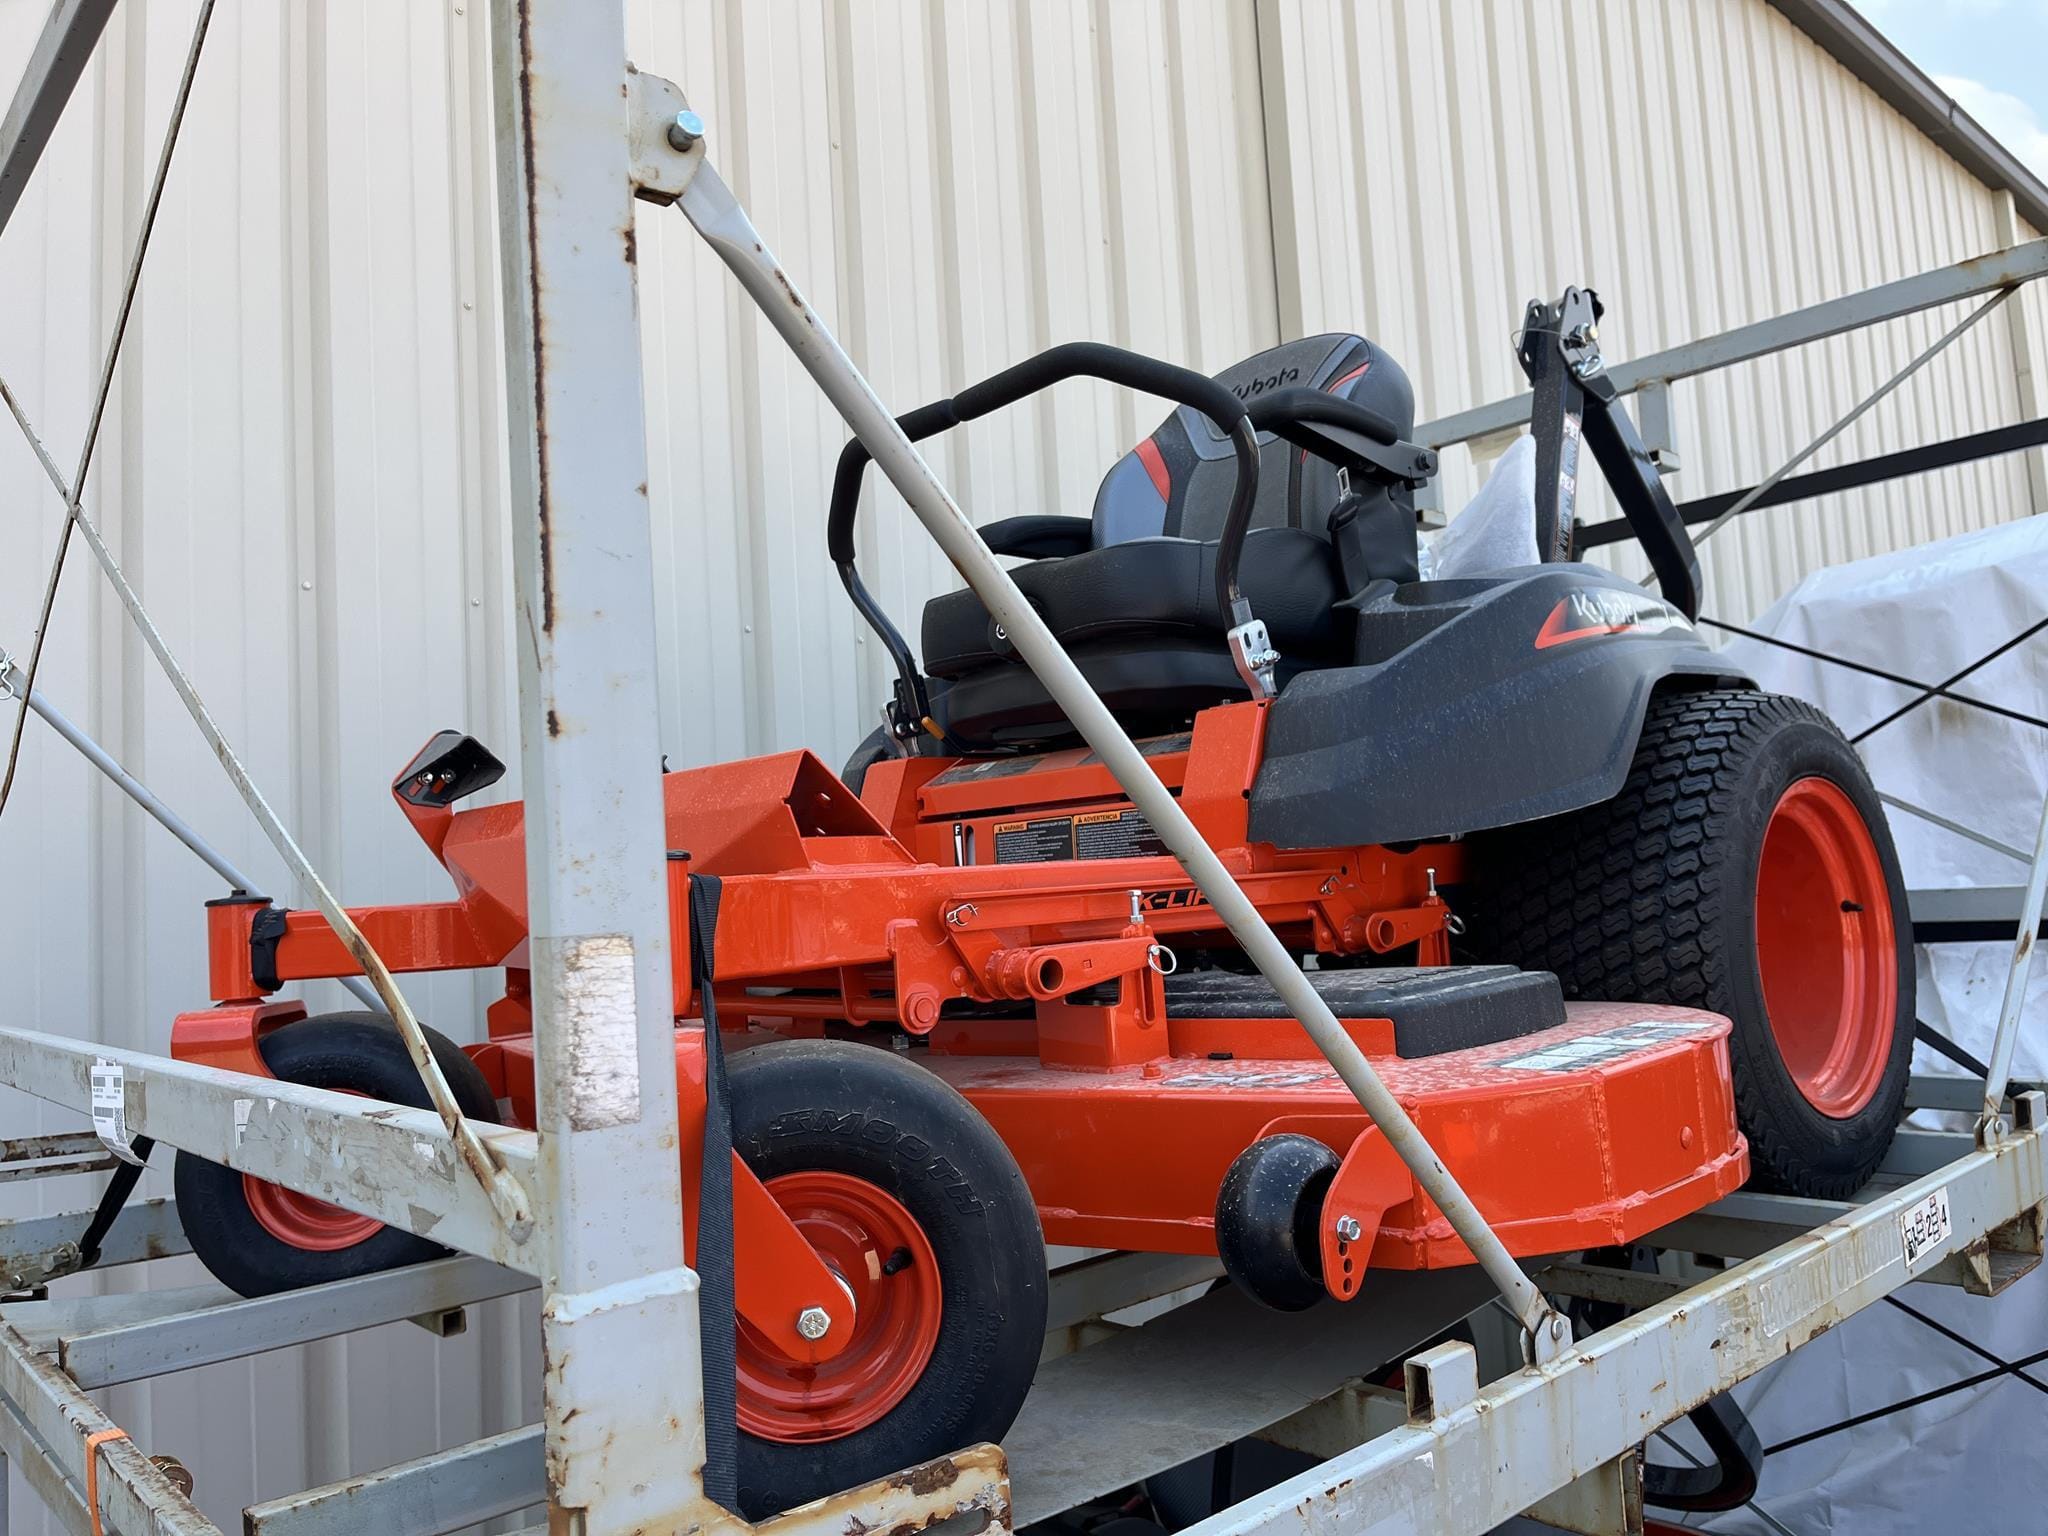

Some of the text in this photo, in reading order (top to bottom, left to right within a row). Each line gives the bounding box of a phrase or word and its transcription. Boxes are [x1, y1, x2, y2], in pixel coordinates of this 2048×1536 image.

[1084, 813, 1118, 823] ADVERTENCIA
[954, 825, 961, 835] F
[1139, 888, 1207, 911] K-LIF
[769, 1108, 985, 1214] SMOOTH
